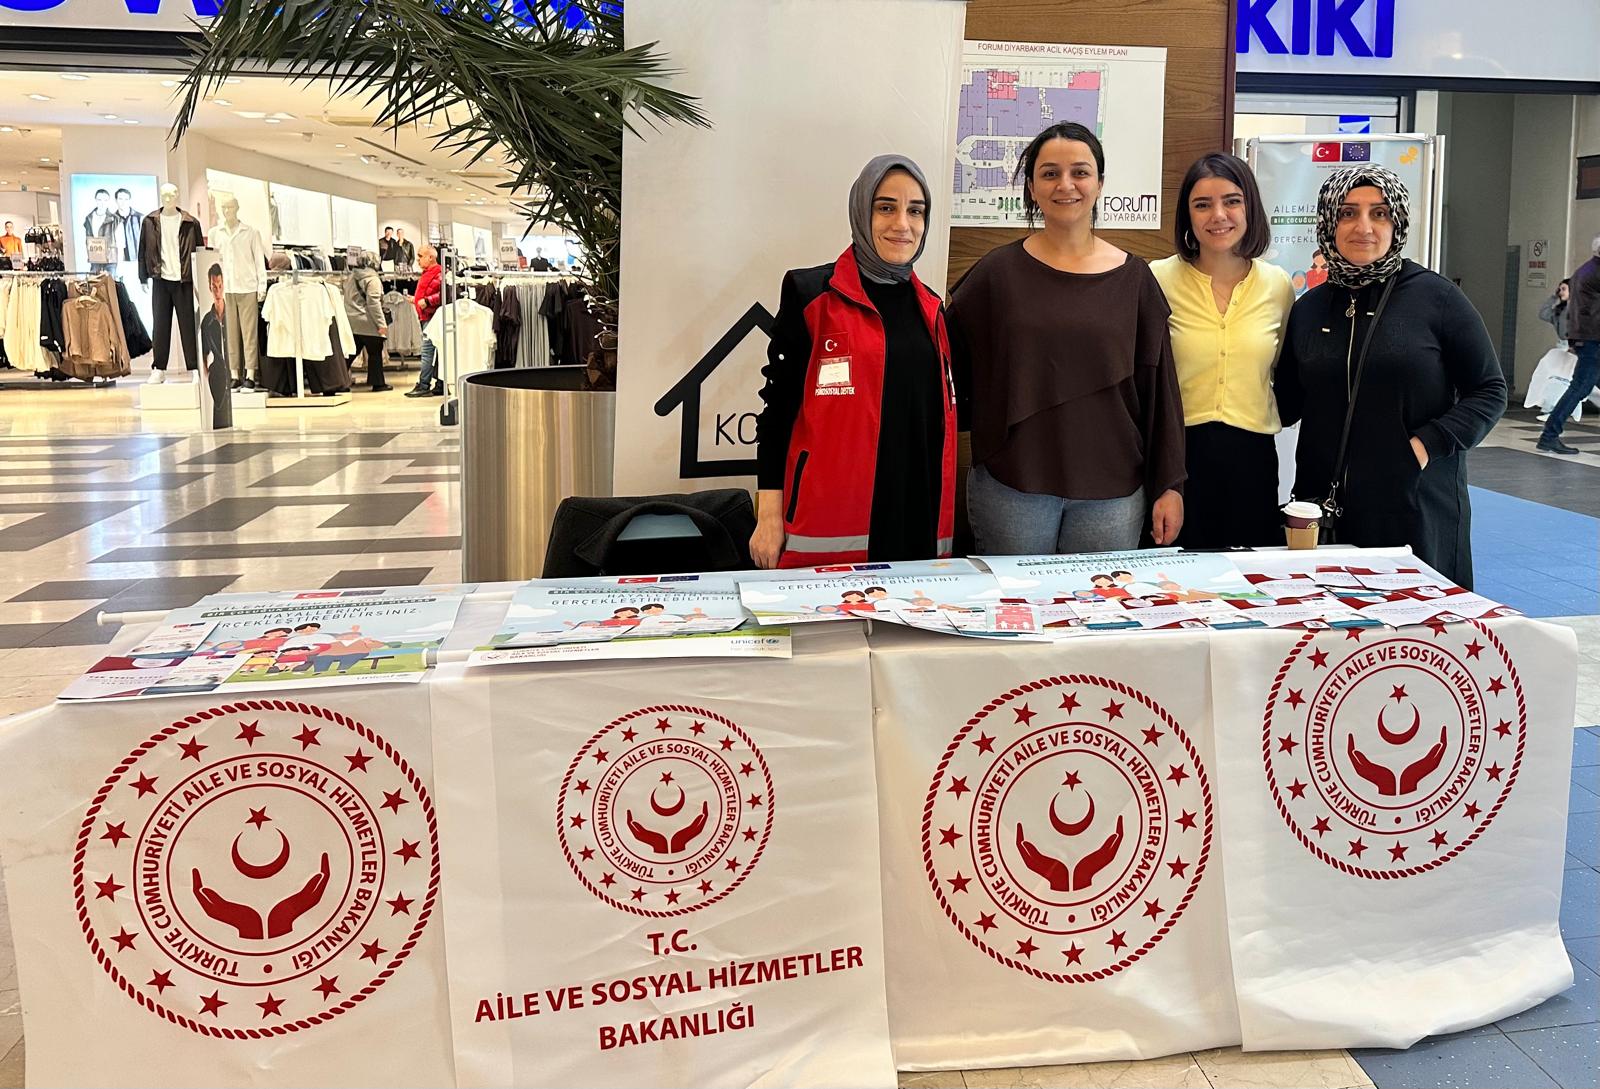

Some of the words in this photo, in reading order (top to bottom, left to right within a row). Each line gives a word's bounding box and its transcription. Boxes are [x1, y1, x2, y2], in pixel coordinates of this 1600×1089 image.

[977, 42, 1003, 51] FORUM
[1004, 42, 1045, 52] DİYARBAKIR
[1046, 44, 1062, 53] ACİL
[1063, 46, 1083, 55] KAÇIŞ
[1108, 48, 1128, 56] PLANI
[1103, 194, 1157, 212] FORUM
[1103, 212, 1157, 222] DİYARBAKIR
[263, 607, 369, 619] HAYALLERİNİ
[1345, 652, 1377, 681] AİLE
[1376, 645, 1397, 662] VE
[1399, 645, 1452, 676] SOSYAL
[1311, 672, 1347, 783] CUMHURİYETİ
[1450, 669, 1482, 754] HİZMETLER
[647, 744, 665, 756] VE
[666, 743, 710, 764] SOSYAL
[1013, 736, 1048, 766] AİLE
[1047, 730, 1070, 747] VE
[1072, 729, 1128, 762] SOSYAL
[223, 763, 253, 782] VE
[256, 761, 329, 794] SOSYAL
[622, 749, 648, 771] AİLE
[182, 771, 225, 807] AİLE
[597, 766, 625, 848] CUMHURİYETİ
[708, 758, 737, 822] HİZMETLER
[1126, 755, 1162, 847] HİZMETLER
[1324, 781, 1377, 827] TÜRKİYE
[1415, 755, 1477, 823] BAKANLIĞI
[328, 785, 378, 884] HİZMETLER
[977, 758, 1016, 878] CUMHURİYETİ
[142, 799, 186, 930] CUMHURİYETİ
[609, 846, 654, 879] TÜRKİYE
[684, 823, 734, 875] BAKANLIĞI
[991, 876, 1049, 926] TÜRKİYE
[1090, 848, 1157, 922] BAKANLIĞI
[291, 887, 373, 970] BAKANLIĞI
[647, 929, 697, 956] T.C.
[163, 927, 239, 977] TÜRKİYE
[474, 992, 540, 1023] AİLE
[545, 986, 584, 1012] VE
[591, 970, 702, 1005] SOSYAL
[708, 945, 864, 989] HİZMETLER
[599, 1002, 755, 1050] BAKANLIĞI
